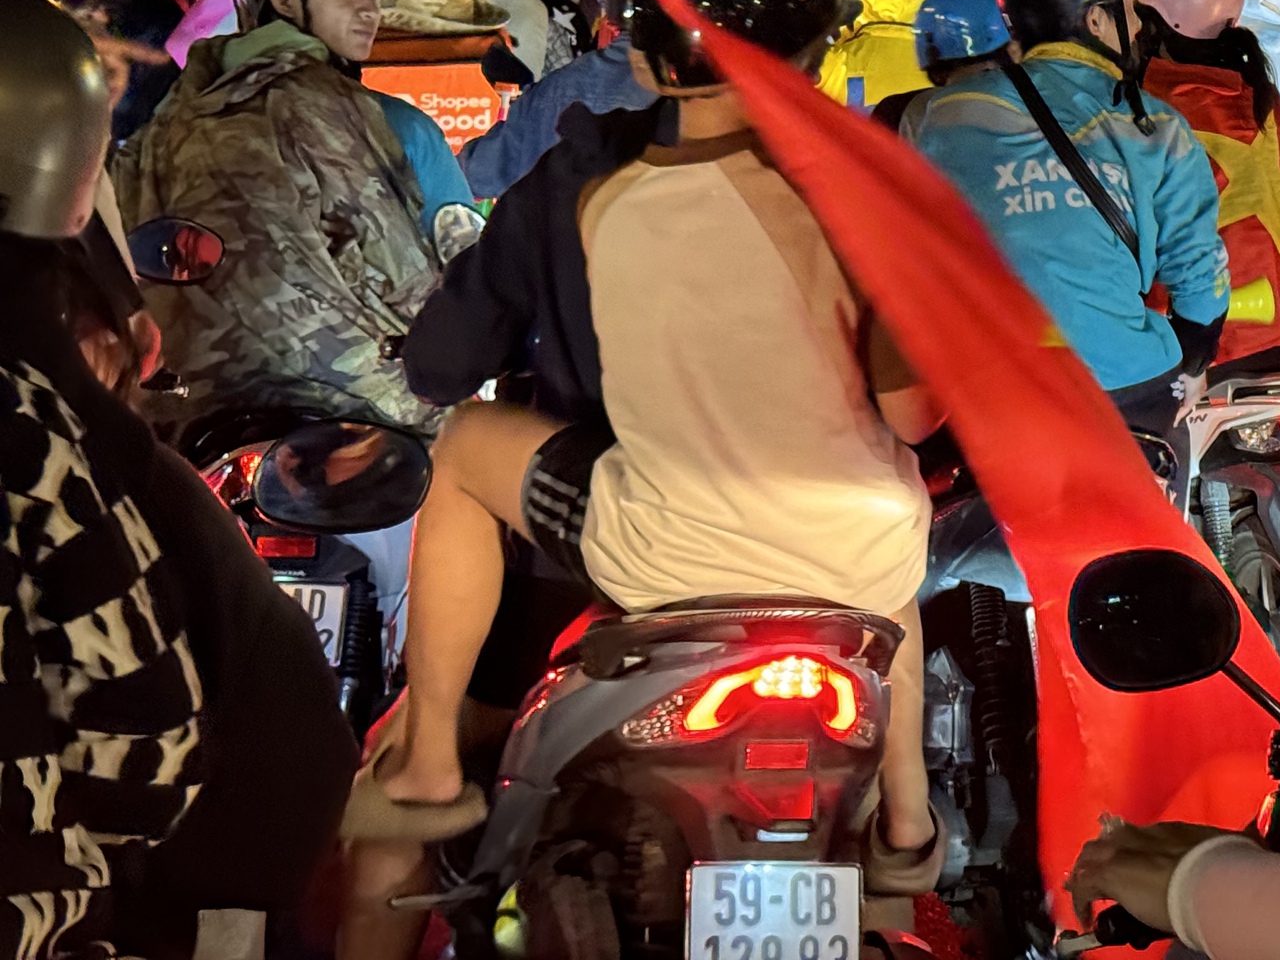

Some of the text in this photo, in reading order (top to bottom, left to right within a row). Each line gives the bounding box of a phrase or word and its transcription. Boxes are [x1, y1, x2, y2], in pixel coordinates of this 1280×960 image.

[420, 93, 492, 113] Shopee
[1003, 185, 1056, 217] xin
[713, 871, 837, 927] 59-CB
